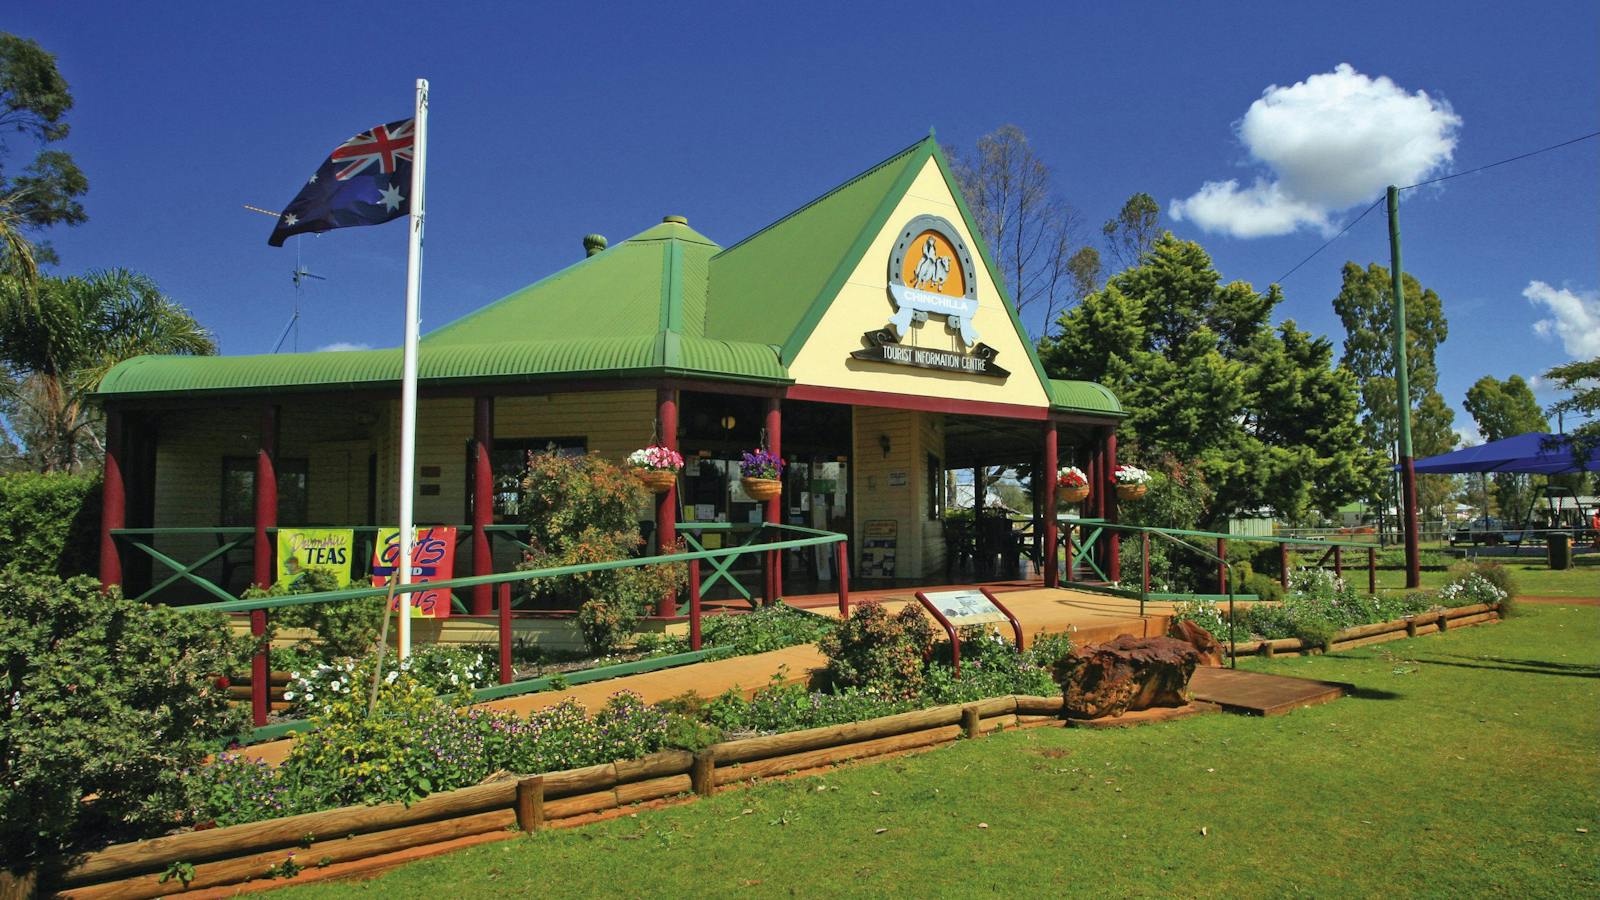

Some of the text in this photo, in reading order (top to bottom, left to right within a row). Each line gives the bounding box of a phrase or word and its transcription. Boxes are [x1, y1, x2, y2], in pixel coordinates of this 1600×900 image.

[903, 290, 968, 311] CHINCHILLA
[882, 345, 987, 371] TOURIST INFORMATION CENTRE
[288, 533, 346, 552] Devonshire
[304, 547, 347, 565] TEAS
